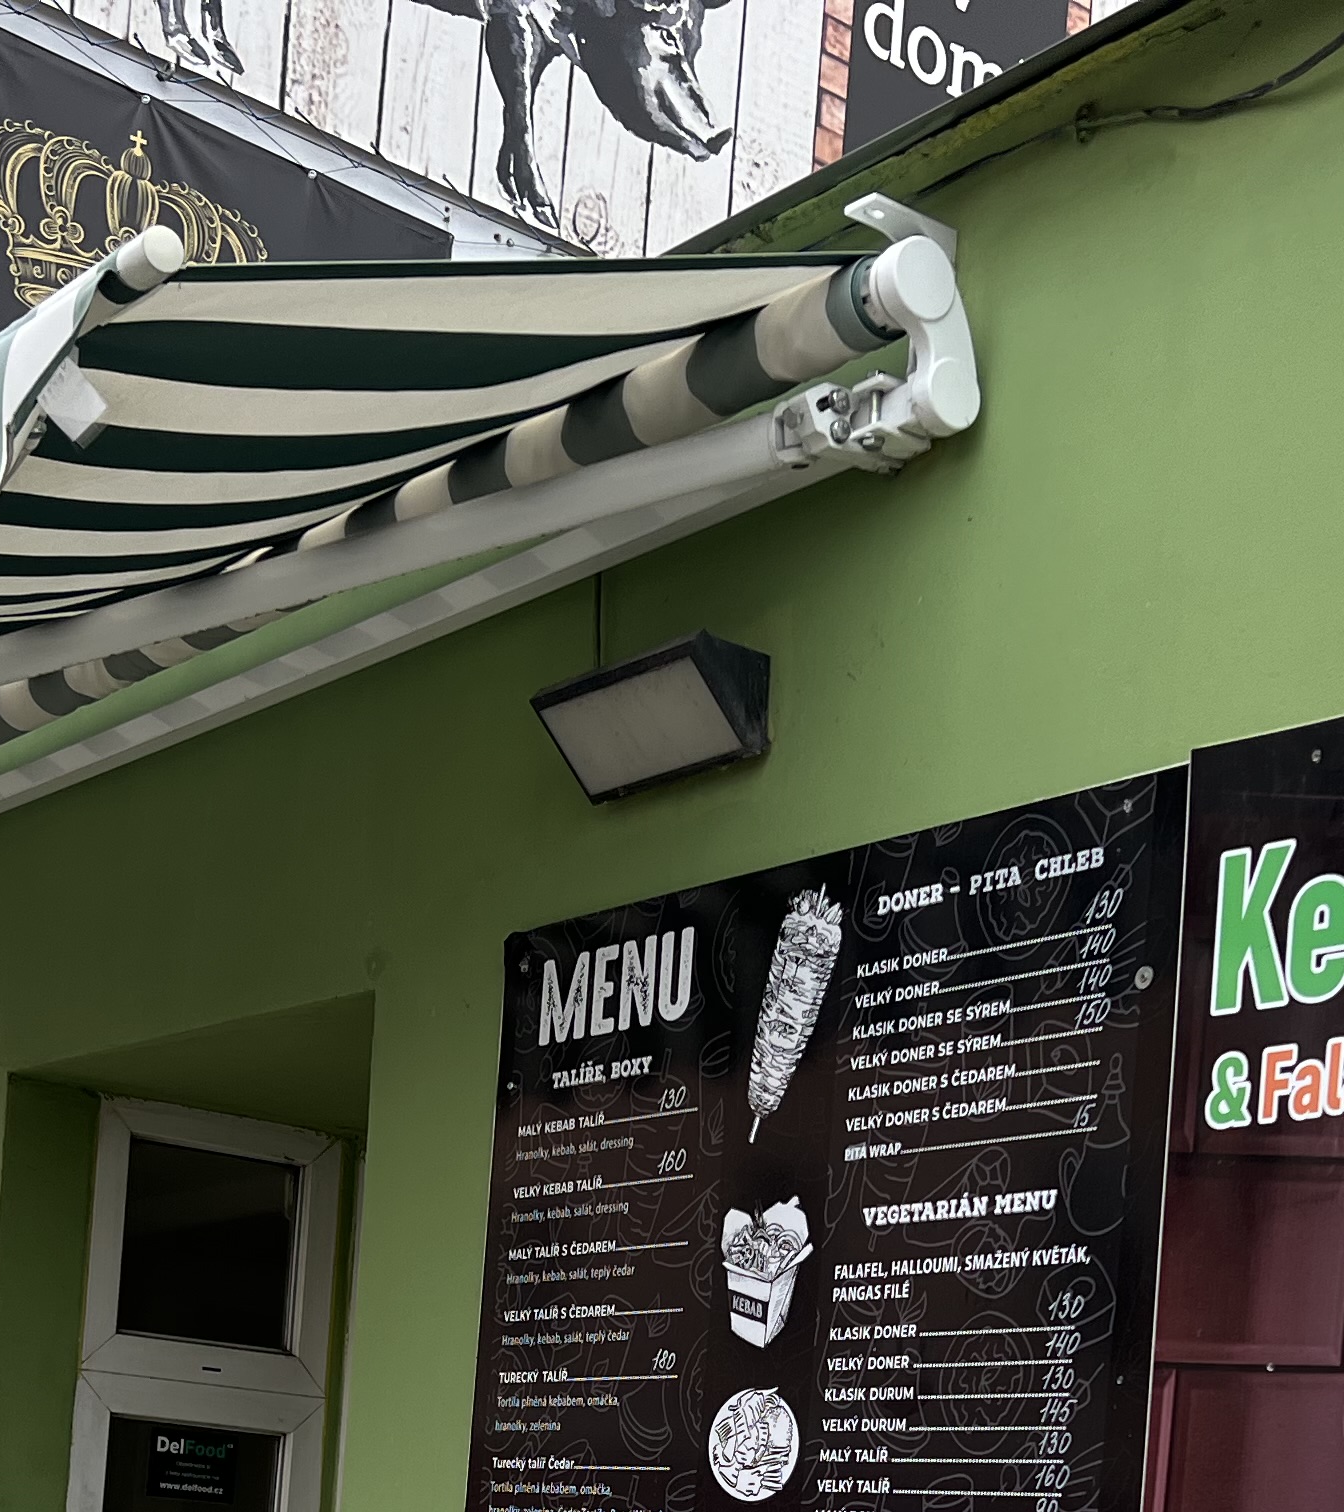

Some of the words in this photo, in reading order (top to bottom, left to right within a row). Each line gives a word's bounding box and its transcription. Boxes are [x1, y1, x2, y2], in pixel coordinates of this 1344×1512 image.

[863, 0, 1026, 97] dom
[877, 883, 944, 915] DONER
[969, 865, 1022, 896] PITA
[1034, 847, 1104, 881] CHLEB
[857, 957, 900, 979] KLASIK
[903, 947, 948, 970] DONER
[1085, 888, 1124, 925] 130
[538, 926, 695, 1047] MENU
[855, 986, 893, 1009] VELKÝ
[895, 980, 940, 1002] DONER
[1079, 926, 1116, 959] 140
[852, 1019, 896, 1040] KLASIK
[898, 1011, 943, 1033] DONER
[946, 1007, 963, 1024] SE
[965, 999, 1011, 1021] SÝREM
[1076, 964, 1113, 994] 140
[850, 1049, 889, 1071] VELKÝ
[890, 1044, 935, 1065] DONER
[937, 1041, 955, 1057] SE
[956, 1033, 1002, 1054] SÝREM
[1074, 998, 1111, 1030] 150
[552, 1060, 606, 1089] TALÍŘE,
[610, 1055, 653, 1079] BOXY
[847, 1082, 891, 1102] KLASIK
[893, 1075, 938, 1095] DONER
[939, 1073, 949, 1088] S
[951, 1063, 1016, 1087] ČEDAREM
[1206, 1051, 1251, 1130] &
[517, 1121, 542, 1138] MALÝ
[544, 1118, 576, 1134] KEBAB
[578, 1111, 605, 1129] TALÍŘ
[657, 1085, 686, 1112] 130
[845, 1110, 884, 1132] VELKÝ
[885, 1108, 930, 1127] DONER
[931, 1106, 940, 1121] S
[942, 1097, 1007, 1119] ČEDAREM
[869, 1142, 902, 1158] WRAP
[1071, 1102, 1096, 1128] 15
[600, 1137, 634, 1150] dressing
[513, 1185, 541, 1199] VELKÝ
[542, 1181, 574, 1196] KEBAB
[576, 1174, 603, 1191] TALÍŘ
[657, 1148, 687, 1175] 160
[862, 1191, 989, 1227] VEGETARIÁN
[993, 1189, 1058, 1215] MENU
[834, 1262, 889, 1280] FALAFEL,
[890, 1256, 962, 1276] HALLOUMI,
[964, 1247, 1030, 1271] SMAŽENÝ
[1032, 1243, 1091, 1267] KVĚTÁK,
[732, 1294, 763, 1319] KEBAB
[832, 1284, 882, 1302] PANGAS
[883, 1279, 910, 1300] FILÉ
[829, 1326, 872, 1341] KLASIK
[873, 1324, 917, 1339] DONER
[1048, 1292, 1085, 1321] 130
[498, 1371, 539, 1384] TURECKÝ
[542, 1368, 568, 1383] TALÍŘ
[652, 1348, 676, 1371] 180
[826, 1353, 864, 1371] VELKÝ
[867, 1355, 910, 1370] DONER
[1045, 1331, 1081, 1357] 140
[824, 1387, 866, 1402] KLASIK
[869, 1386, 914, 1401] DURUM
[1041, 1365, 1074, 1390] 130
[822, 1415, 859, 1432] VELKÝ
[861, 1418, 907, 1432] DURUM
[1039, 1398, 1078, 1423] 145
[819, 1445, 852, 1463] MALÝ
[854, 1446, 888, 1463] TALÍŘ
[1038, 1431, 1072, 1455] 130
[817, 1476, 854, 1493] VELKÝ
[856, 1477, 890, 1494] TALÍŘ
[1035, 1464, 1070, 1490] 160
